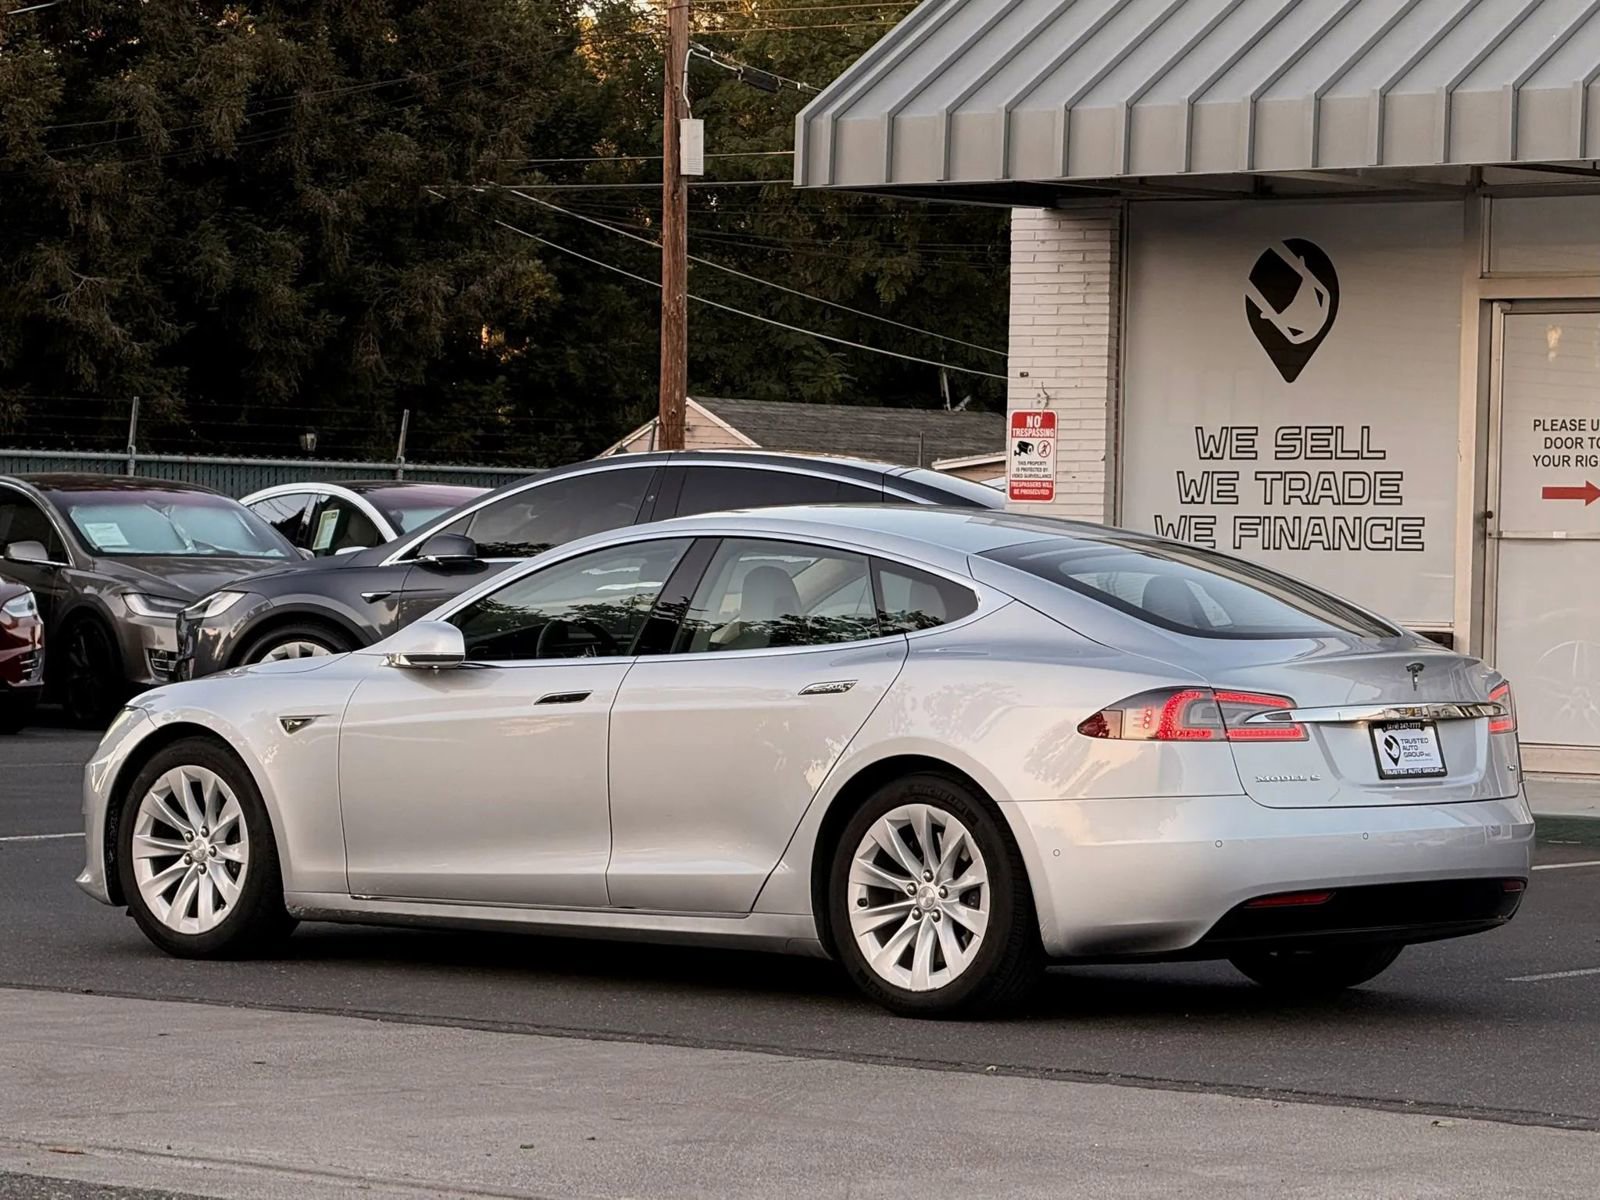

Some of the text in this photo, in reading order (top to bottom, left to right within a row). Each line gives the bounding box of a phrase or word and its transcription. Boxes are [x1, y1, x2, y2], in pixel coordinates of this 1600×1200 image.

[1026, 415, 1041, 428] NO
[1533, 418, 1587, 432] PLEASE
[1012, 428, 1055, 437] TRESPASSING
[1195, 426, 1386, 460] WE SELL
[1544, 436, 1584, 449] DOOR
[1532, 454, 1571, 467] YOUR
[1176, 471, 1403, 505] WE TRADE
[1154, 515, 1425, 551] WE FINANCE
